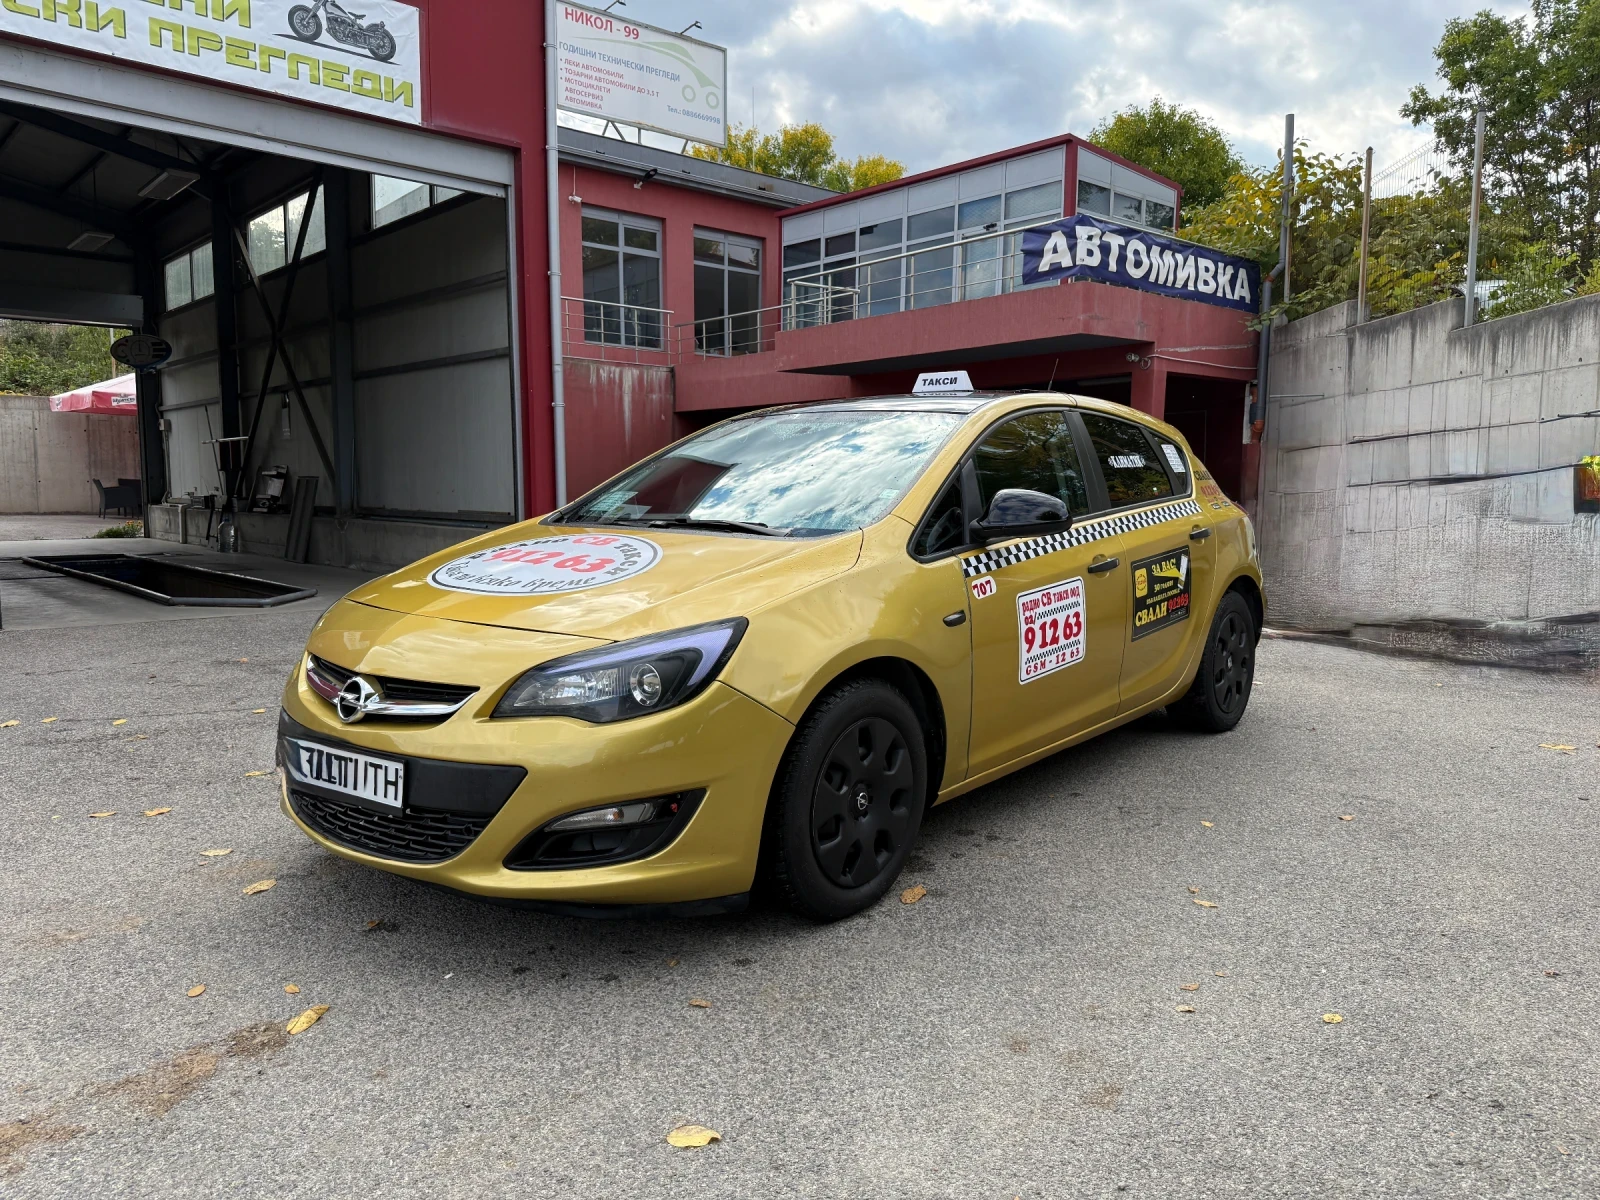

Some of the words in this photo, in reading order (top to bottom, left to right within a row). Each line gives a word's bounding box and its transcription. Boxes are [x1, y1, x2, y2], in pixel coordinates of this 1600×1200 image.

[565, 7, 613, 33] НИКОЛ
[623, 25, 640, 40] 99
[149, 17, 414, 108] ПРЕГЛЕДИ
[559, 41, 597, 59] ГОДИШНИ
[597, 52, 644, 73] ТЕХНИЧЕСКИ
[645, 65, 680, 82] ПРЕГЛЕДИ
[564, 58, 580, 68] ЛЕКИ
[581, 63, 624, 79] АВТОМОБИЛИ
[564, 77, 611, 94] МОТОЦИКЛЕТИ
[564, 86, 604, 101] АВТОСЕРВИЗ
[594, 75, 636, 91] АВТОМОБИЛИ
[637, 86, 646, 94] ДО
[564, 95, 603, 110] АВТОМИВКА
[1038, 225, 1251, 303] АВТОМИВКА
[922, 377, 958, 386] ТАКСИ
[972, 580, 993, 598] 707
[1041, 591, 1052, 607] СВ
[1063, 611, 1083, 641] 63
[1025, 659, 1047, 676] GSM
